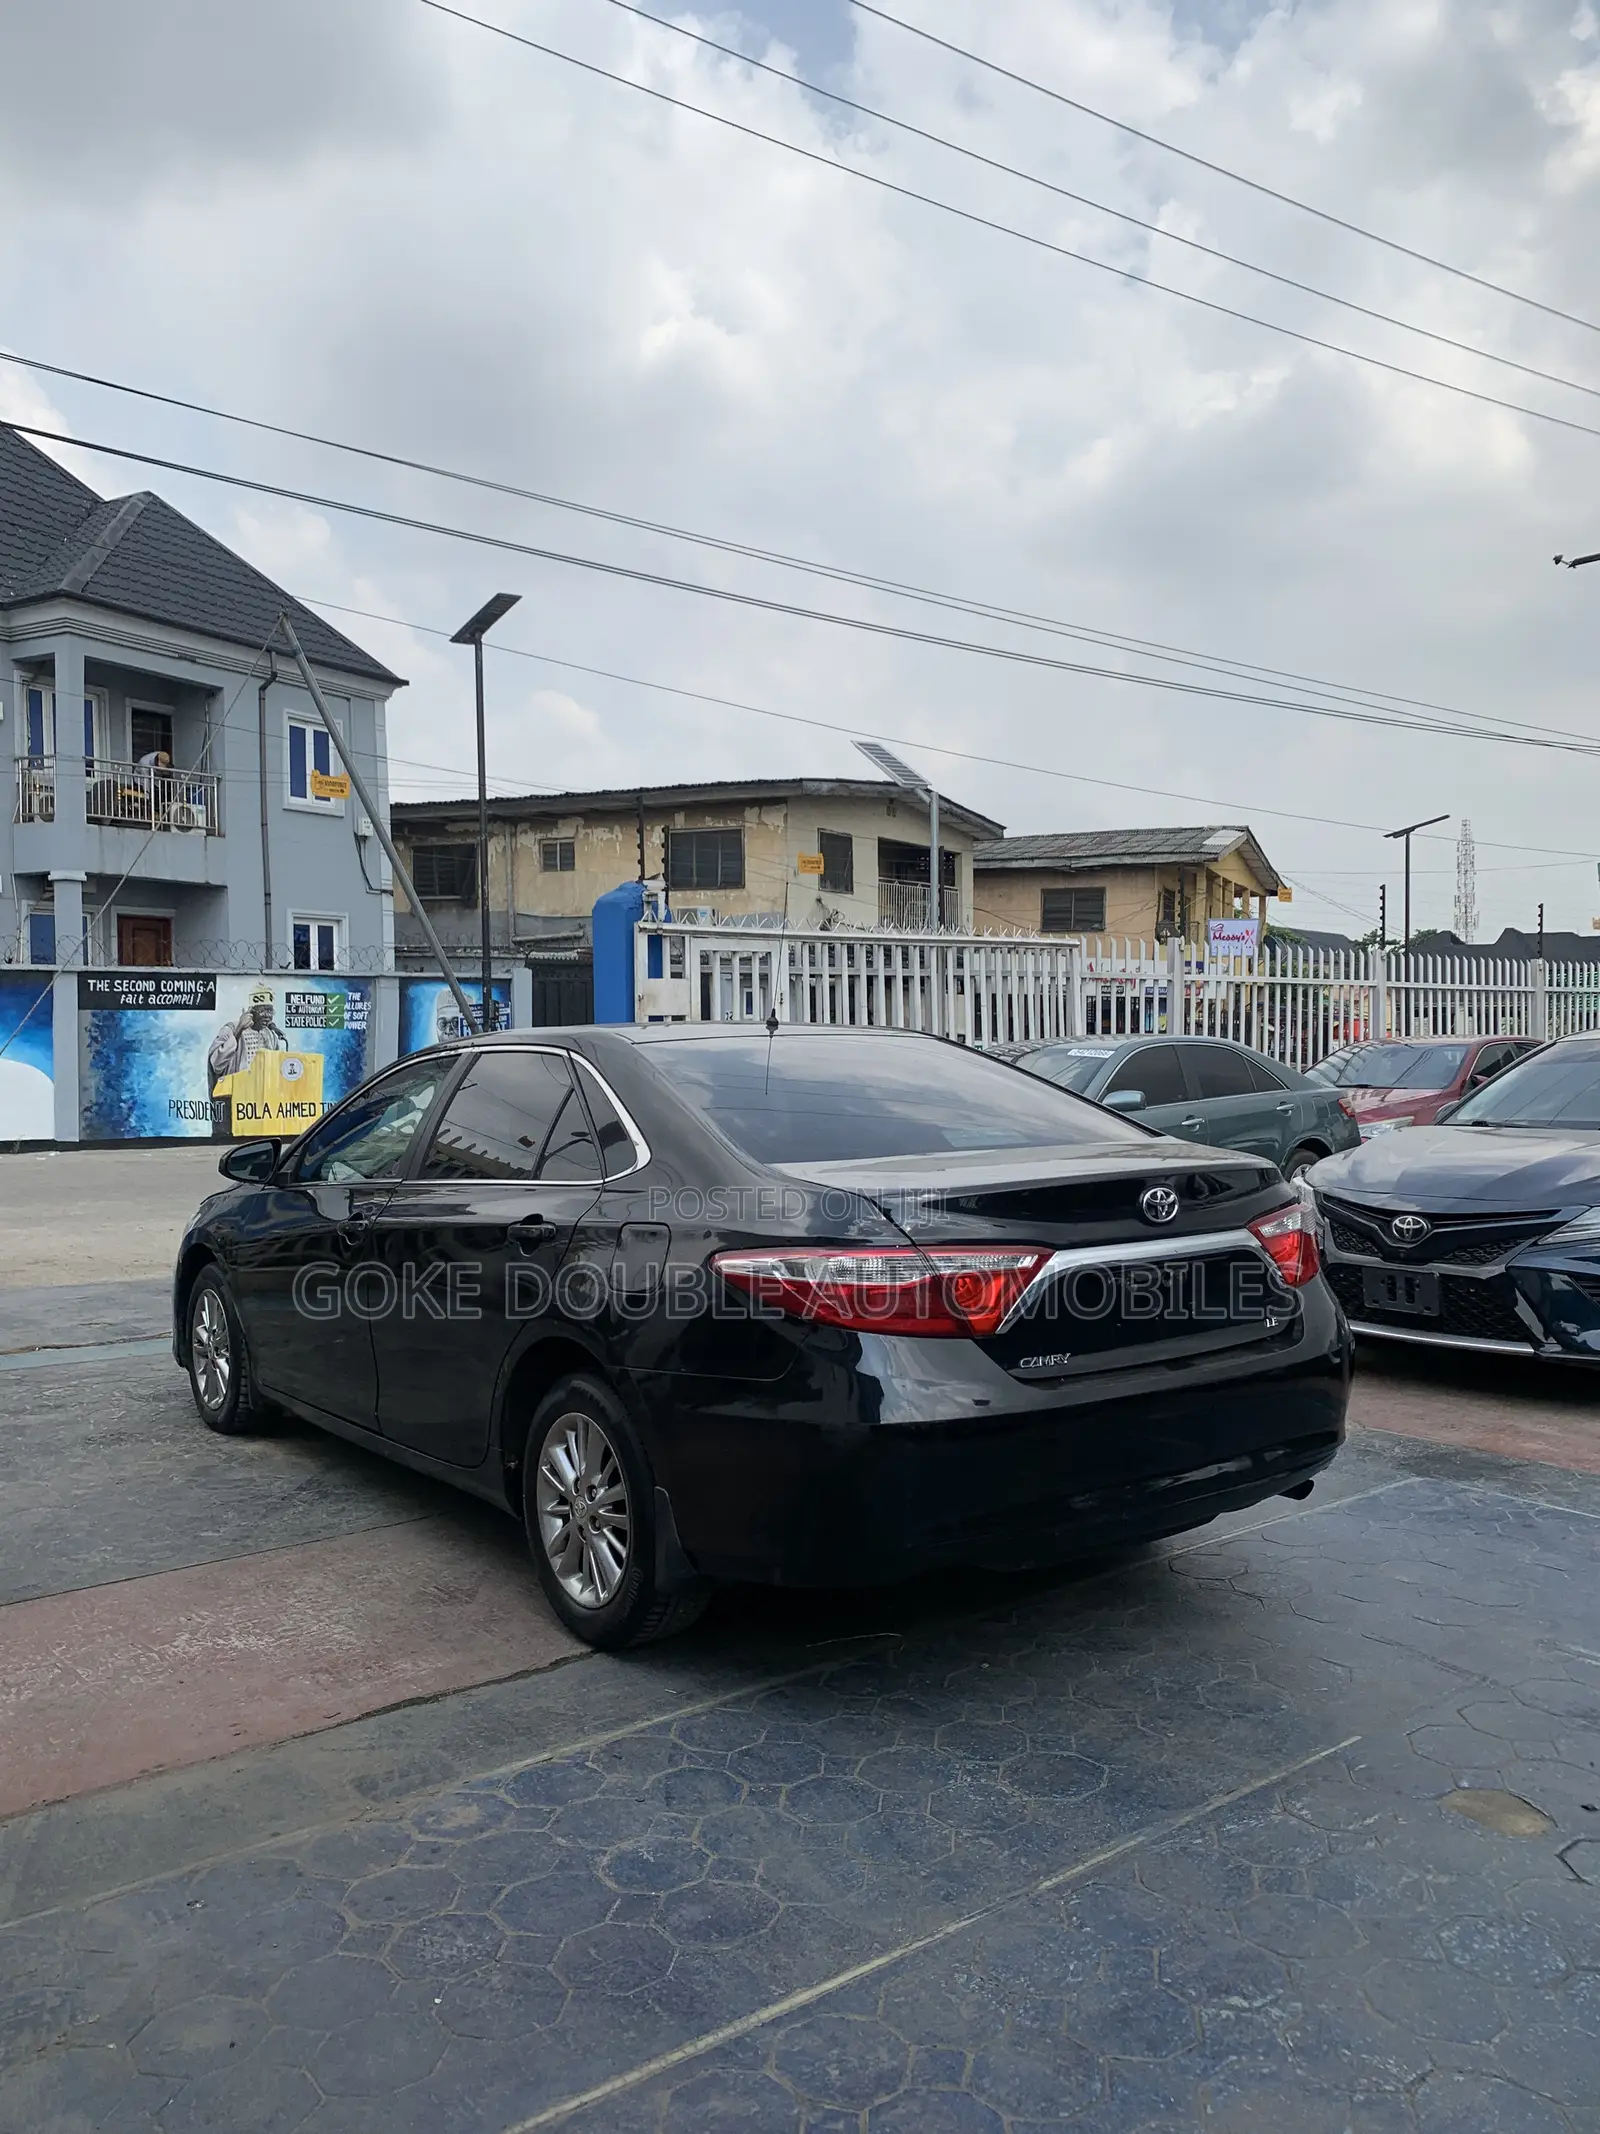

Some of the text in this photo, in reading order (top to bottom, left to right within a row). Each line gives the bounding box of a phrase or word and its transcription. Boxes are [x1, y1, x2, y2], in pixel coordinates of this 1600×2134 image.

[88, 980, 110, 992] THE
[113, 980, 156, 992] SECOND
[348, 992, 361, 1000] THE
[352, 1011, 368, 1020] SOFT
[344, 1021, 367, 1030] POWER
[168, 1100, 226, 1122] PRESIDENT
[236, 1103, 272, 1121] BOLA
[276, 1103, 316, 1119] AHMED
[1019, 1352, 1072, 1369] CAMRY
